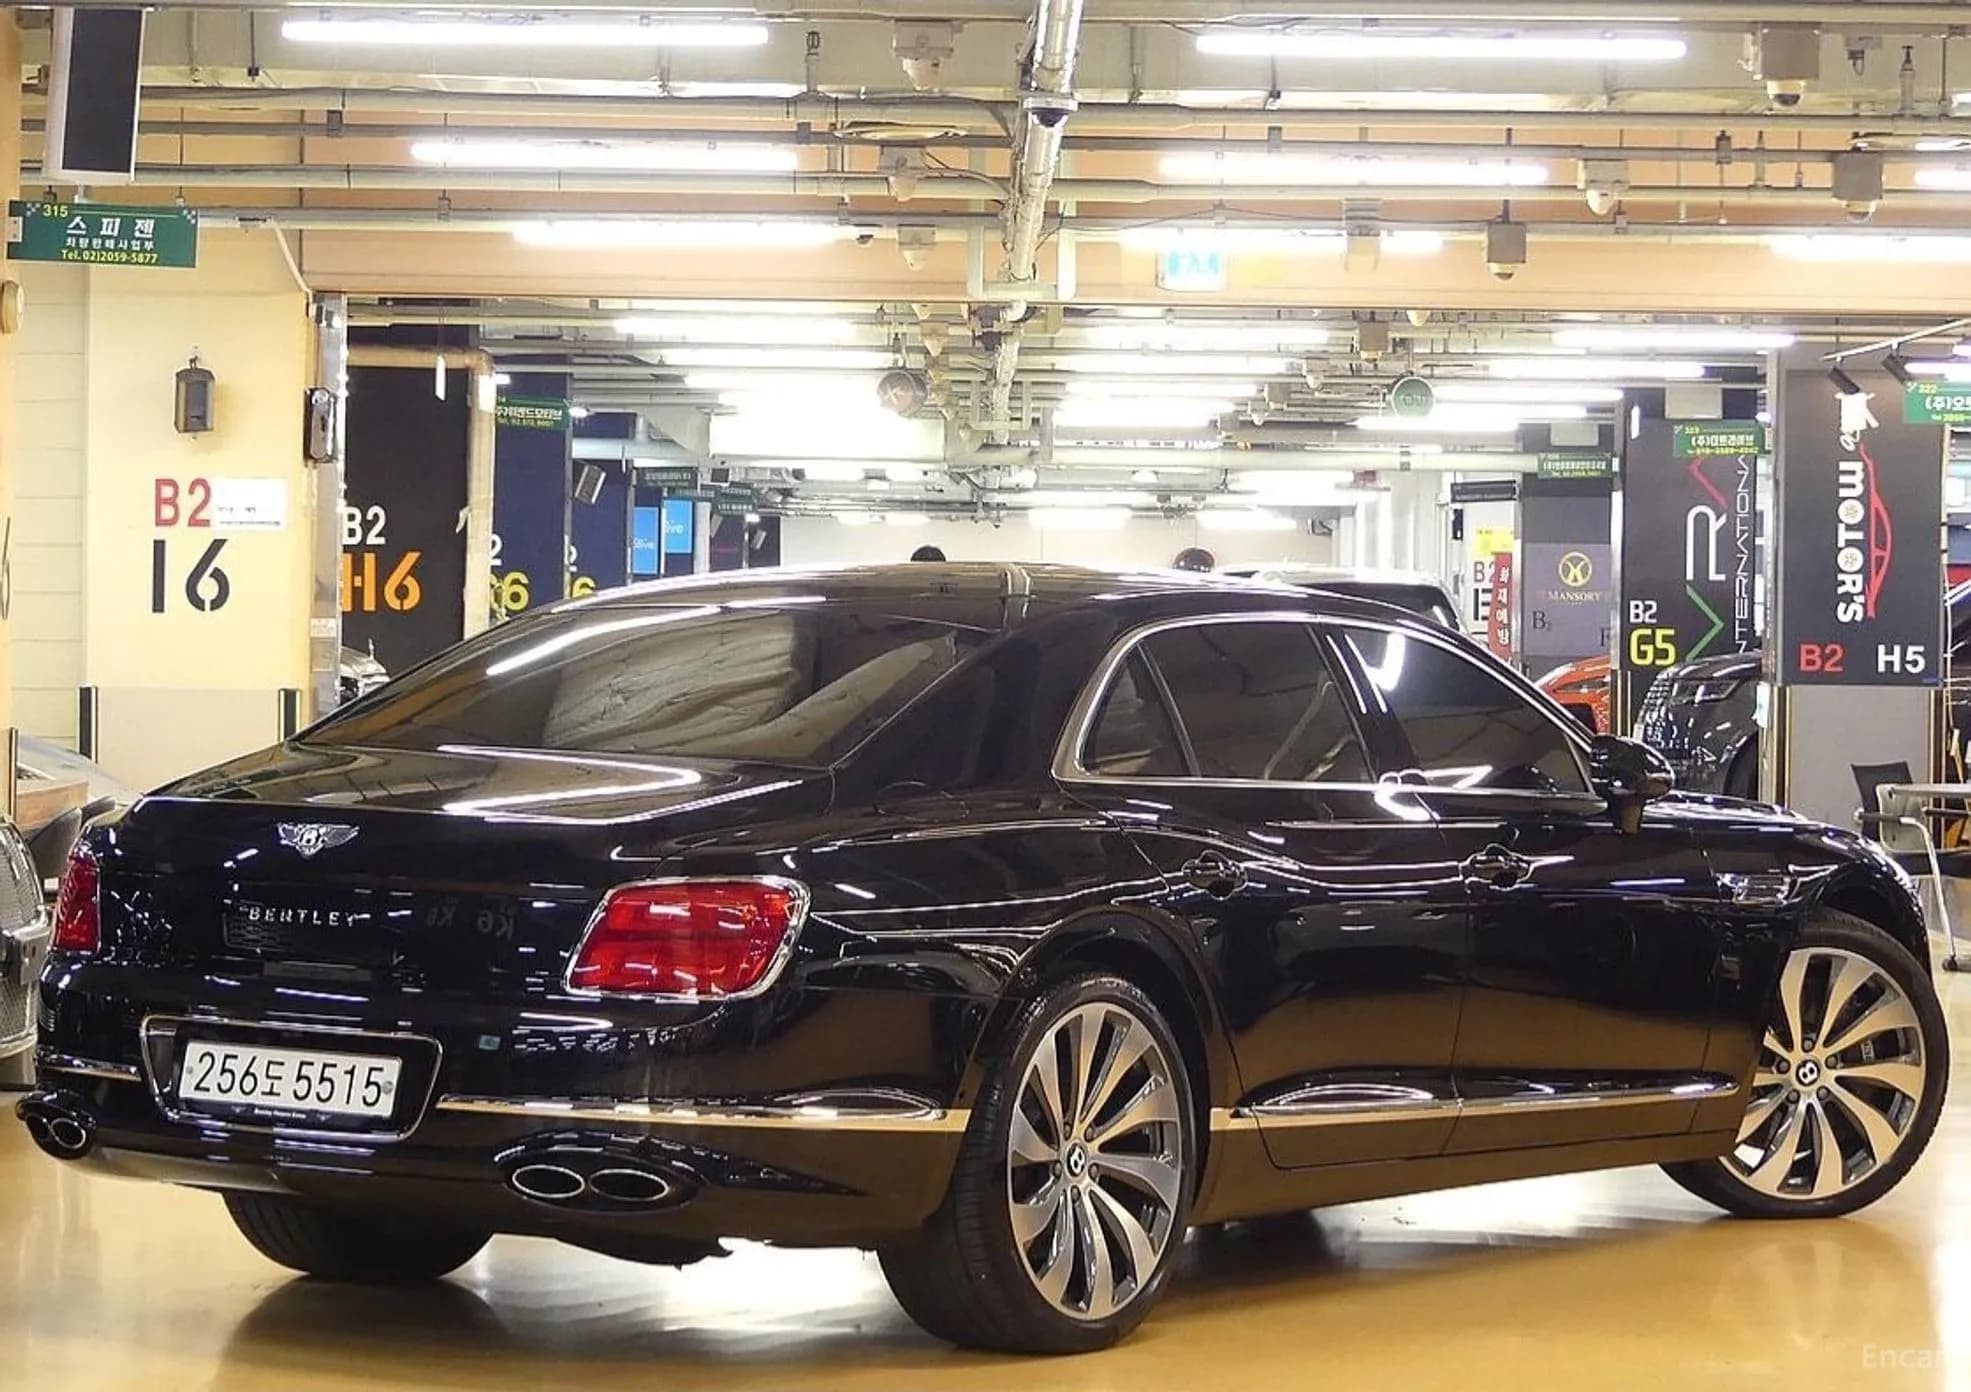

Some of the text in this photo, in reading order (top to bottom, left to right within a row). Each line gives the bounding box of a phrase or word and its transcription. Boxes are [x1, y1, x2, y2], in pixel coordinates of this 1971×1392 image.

[43, 204, 69, 217] 315
[66, 216, 155, 238] 스피젠
[155, 477, 211, 527] B2
[342, 505, 387, 545] B2
[490, 533, 503, 567] 2
[1735, 455, 1750, 654] NTERNATIONA
[152, 538, 230, 613] 16
[340, 551, 422, 612] H6
[1547, 591, 1601, 601] MANSORY
[1629, 600, 1658, 624] B2
[1629, 628, 1677, 666] G5
[1800, 643, 1926, 673] B2 H5
[249, 908, 354, 928] BENTLEY
